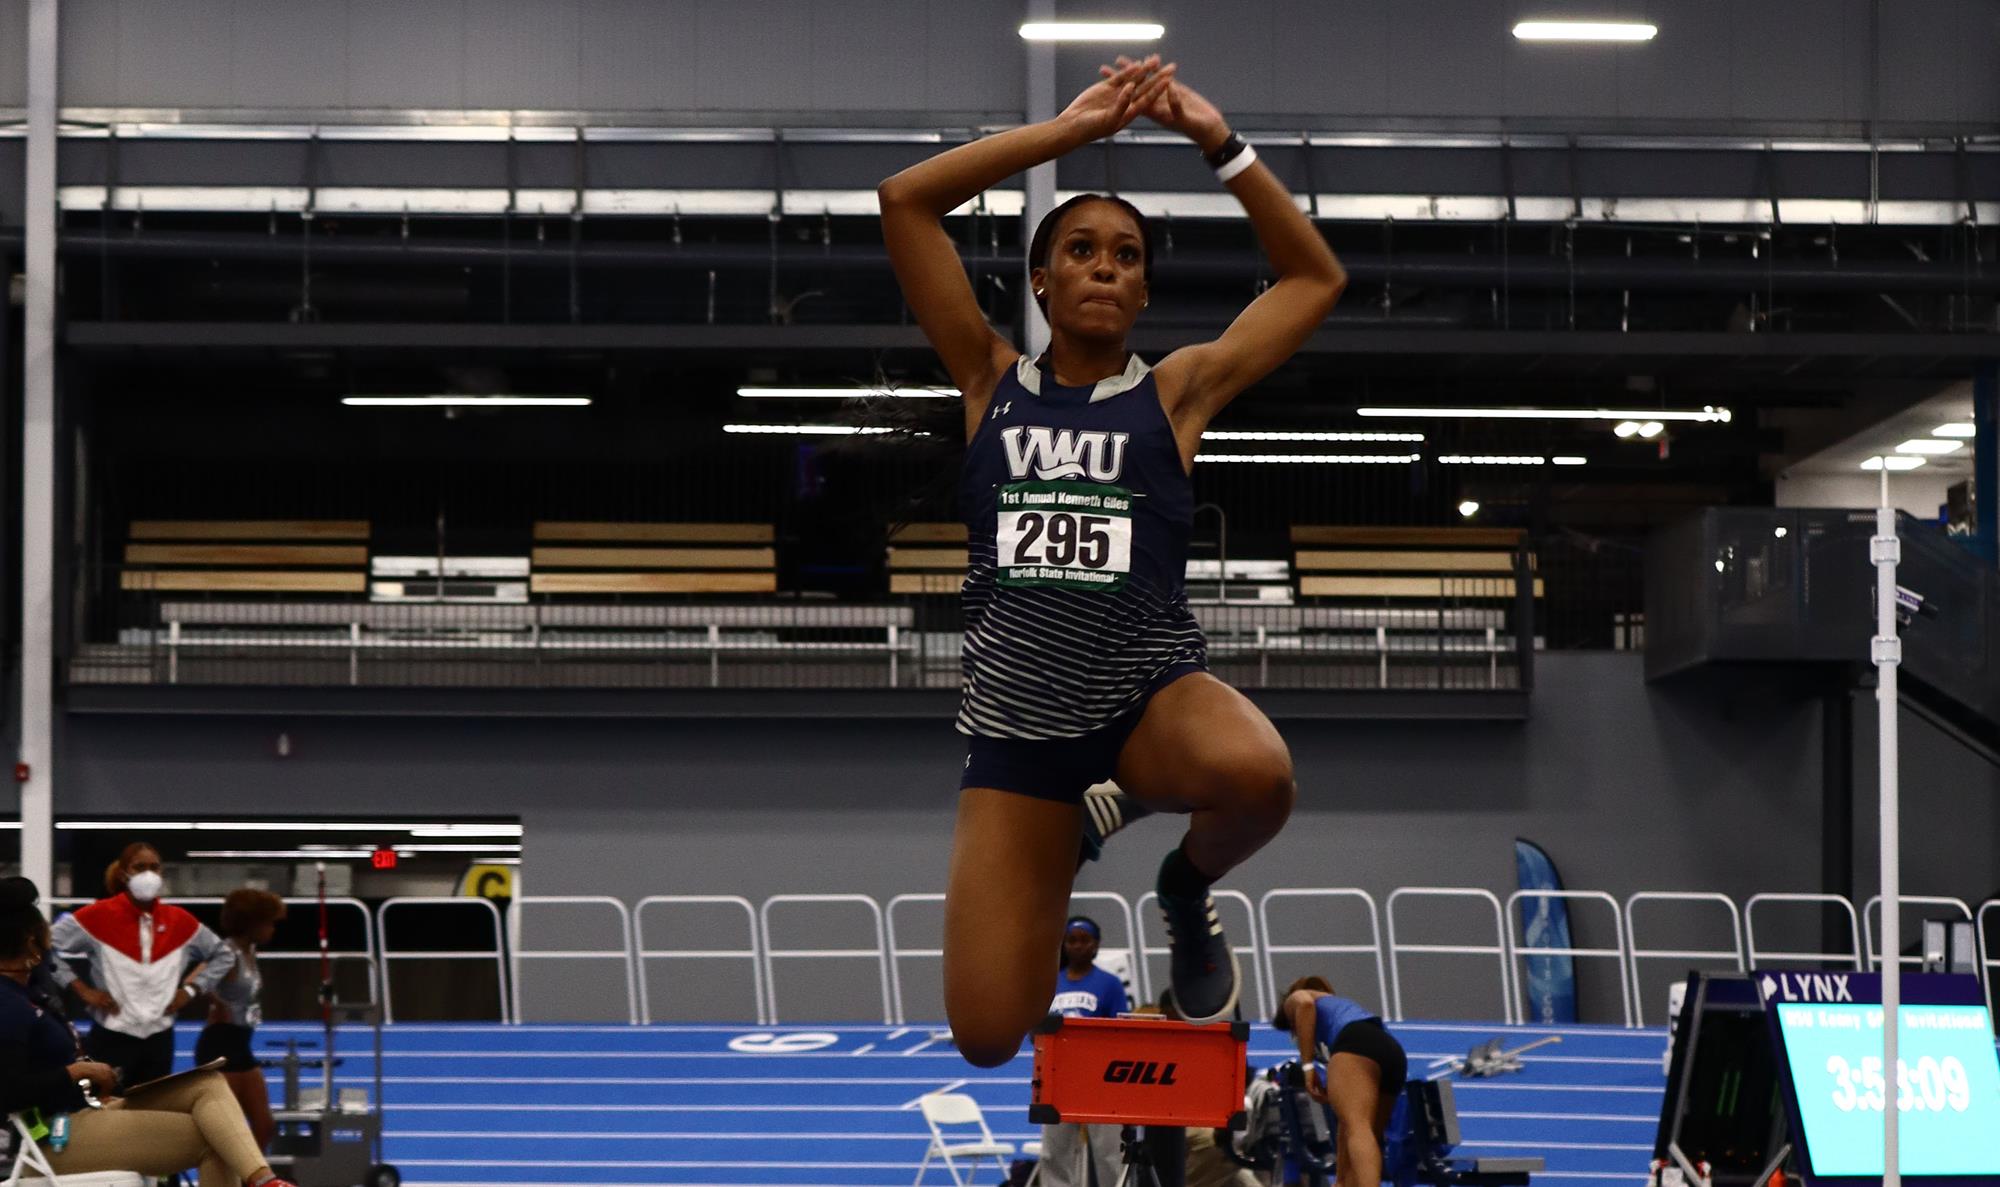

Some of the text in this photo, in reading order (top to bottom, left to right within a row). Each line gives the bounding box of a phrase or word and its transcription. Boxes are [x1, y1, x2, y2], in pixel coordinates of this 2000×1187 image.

[1000, 425, 1129, 483] VWU
[1002, 492, 1129, 511] 1st Annual Kenneth Giles
[1014, 512, 1110, 568] 295
[1009, 567, 1038, 579] Norfolk
[1039, 568, 1063, 580] State
[1781, 974, 1852, 1001] LYNX
[1103, 1060, 1178, 1086] GILL
